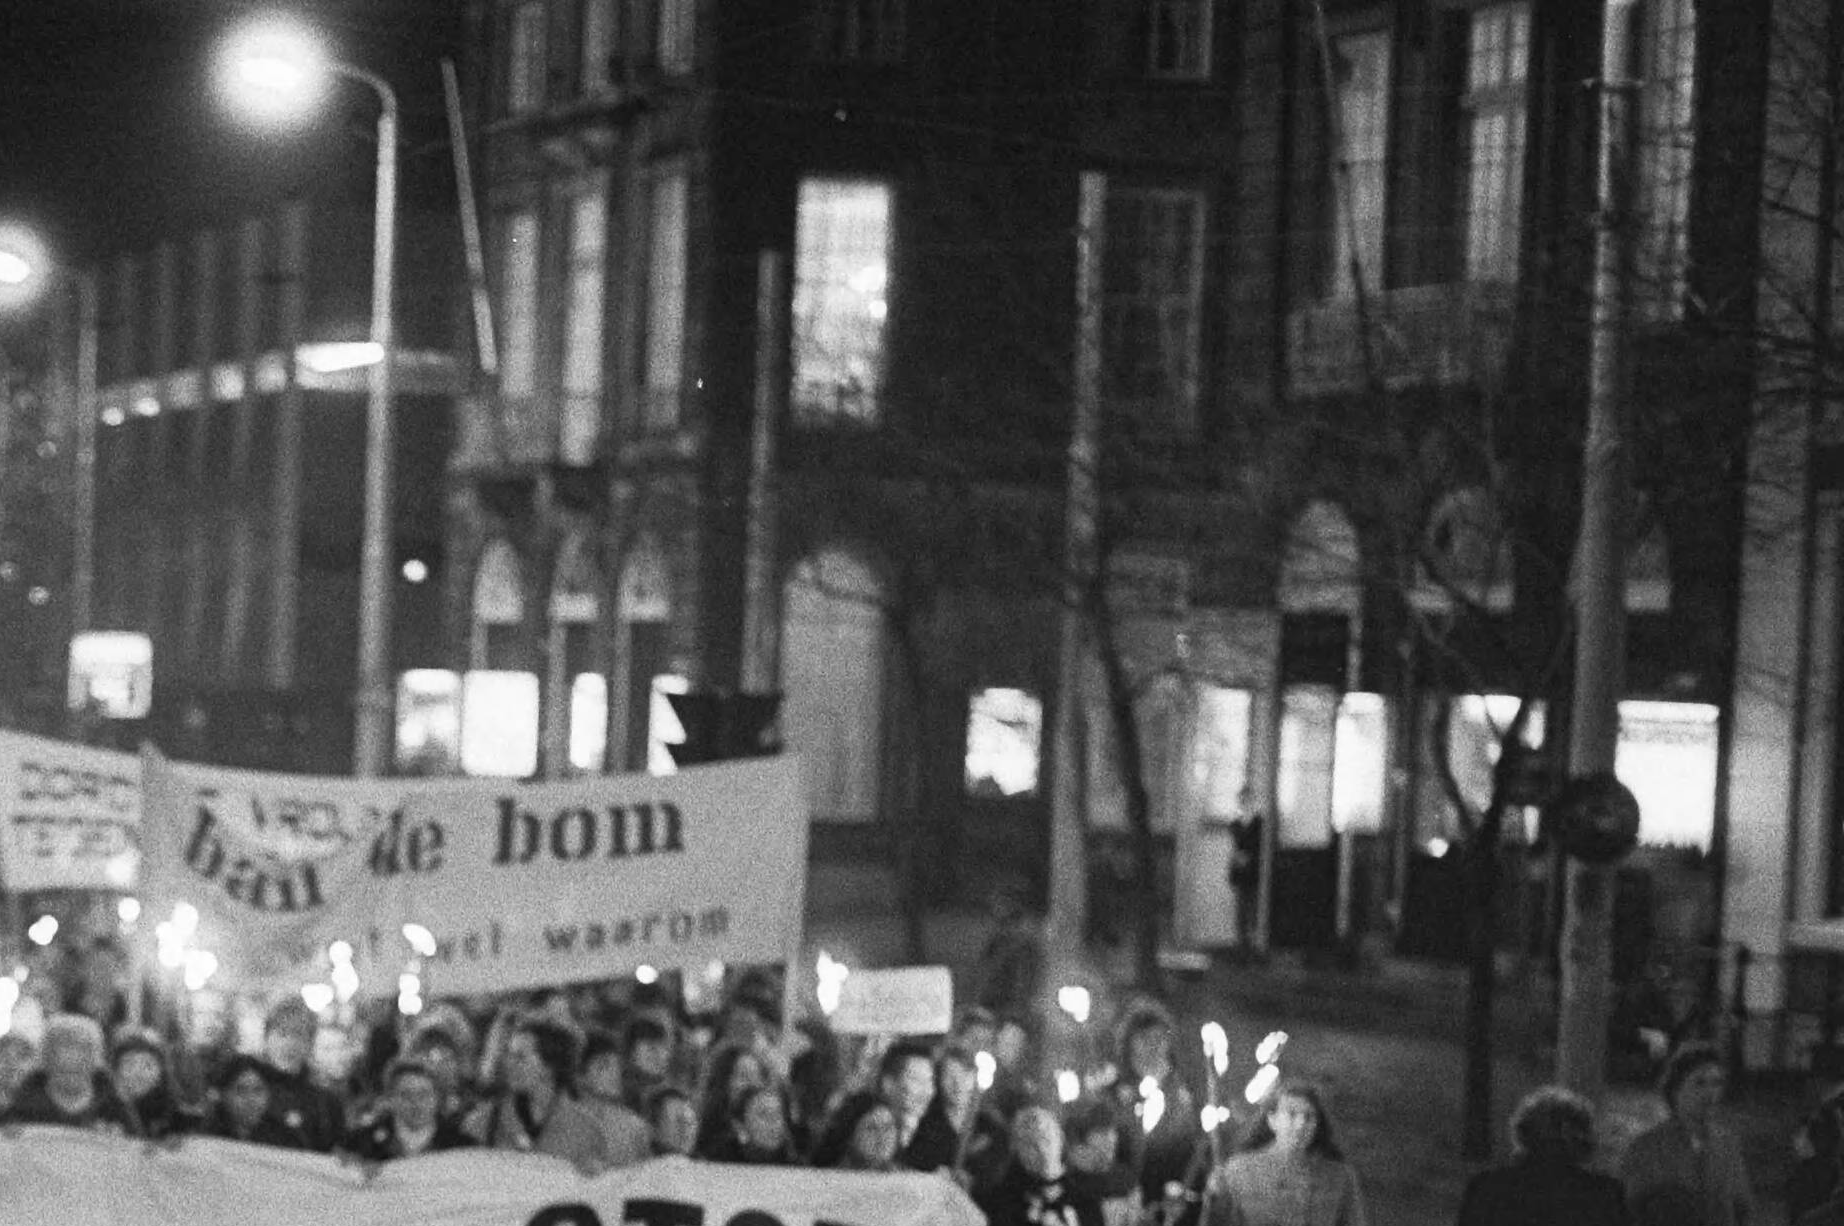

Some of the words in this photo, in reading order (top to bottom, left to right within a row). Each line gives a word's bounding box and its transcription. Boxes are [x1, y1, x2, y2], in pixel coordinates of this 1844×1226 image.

[368, 806, 444, 878] de
[494, 798, 684, 866] bom
[542, 906, 730, 954] waarom
